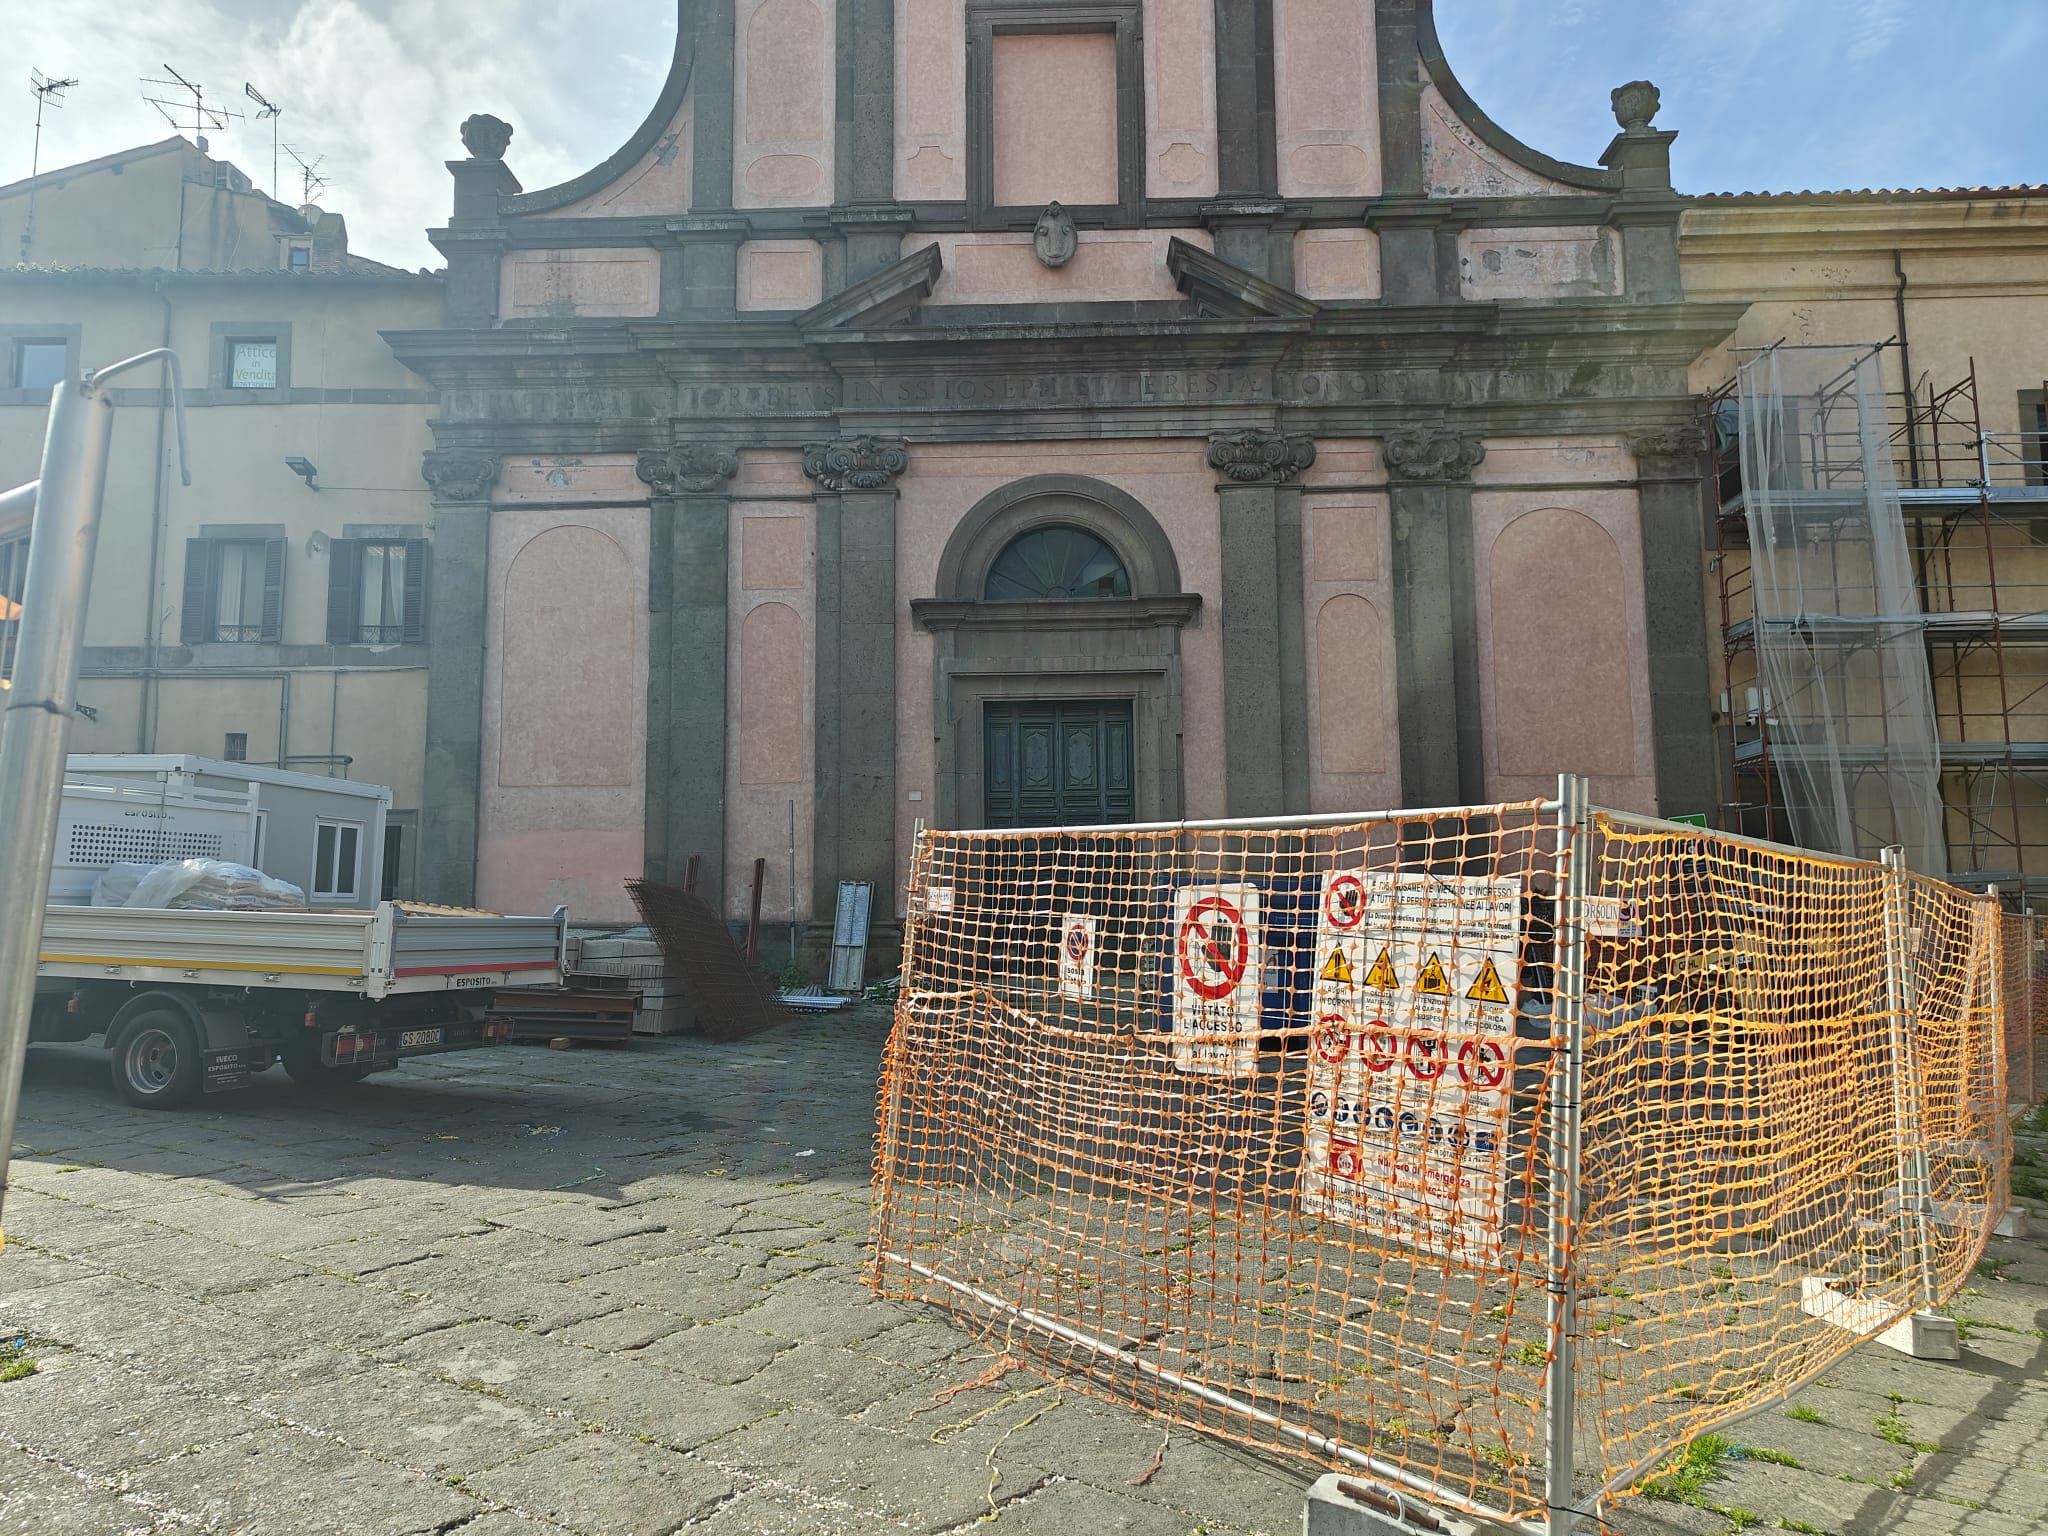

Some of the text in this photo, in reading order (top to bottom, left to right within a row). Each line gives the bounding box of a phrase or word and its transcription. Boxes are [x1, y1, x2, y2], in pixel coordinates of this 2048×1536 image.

[251, 359, 261, 367] in
[1377, 895, 1397, 904] TUTT
[1438, 899, 1475, 909] ESTRNEE
[1486, 902, 1512, 913] LAVORI
[1487, 923, 1513, 931] cofronti
[456, 977, 491, 987] ESPOSITO
[1325, 985, 1348, 996] AVORI
[1415, 996, 1450, 1007] TTENZIONE
[1192, 1004, 1234, 1017] VIETATO
[1468, 1012, 1505, 1024] ELTRICA
[1184, 1018, 1243, 1033] L'ACCESSO
[1464, 1020, 1508, 1033] PERCOLOSA
[216, 1054, 238, 1063] IVECO
[1204, 1048, 1232, 1058] lavor
[1377, 1157, 1410, 1173] Nuero
[1423, 1169, 1471, 1188] emergeza
[1338, 1206, 1361, 1221] PICCOA
